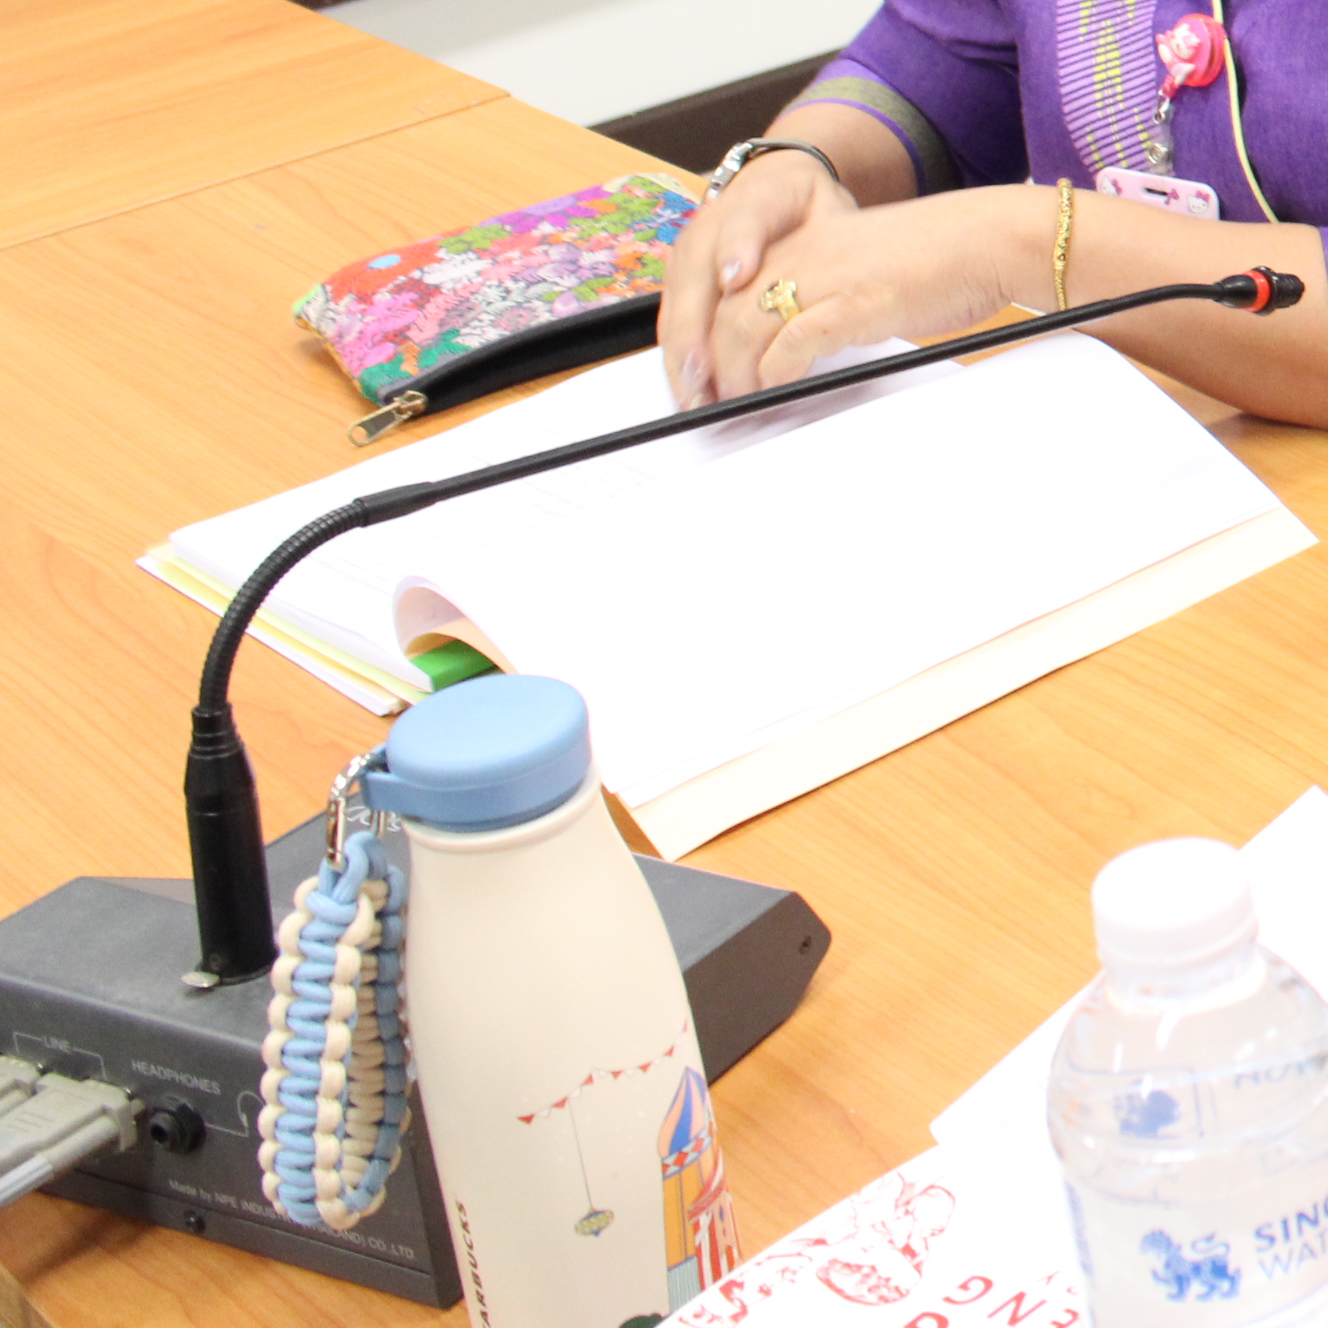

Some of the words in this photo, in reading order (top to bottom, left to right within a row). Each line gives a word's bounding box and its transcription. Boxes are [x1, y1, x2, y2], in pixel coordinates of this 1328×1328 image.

[43, 1035, 71, 1053] LINE
[131, 1059, 221, 1095] HEADPHONES
[454, 1196, 491, 1328] ARBUCKS
